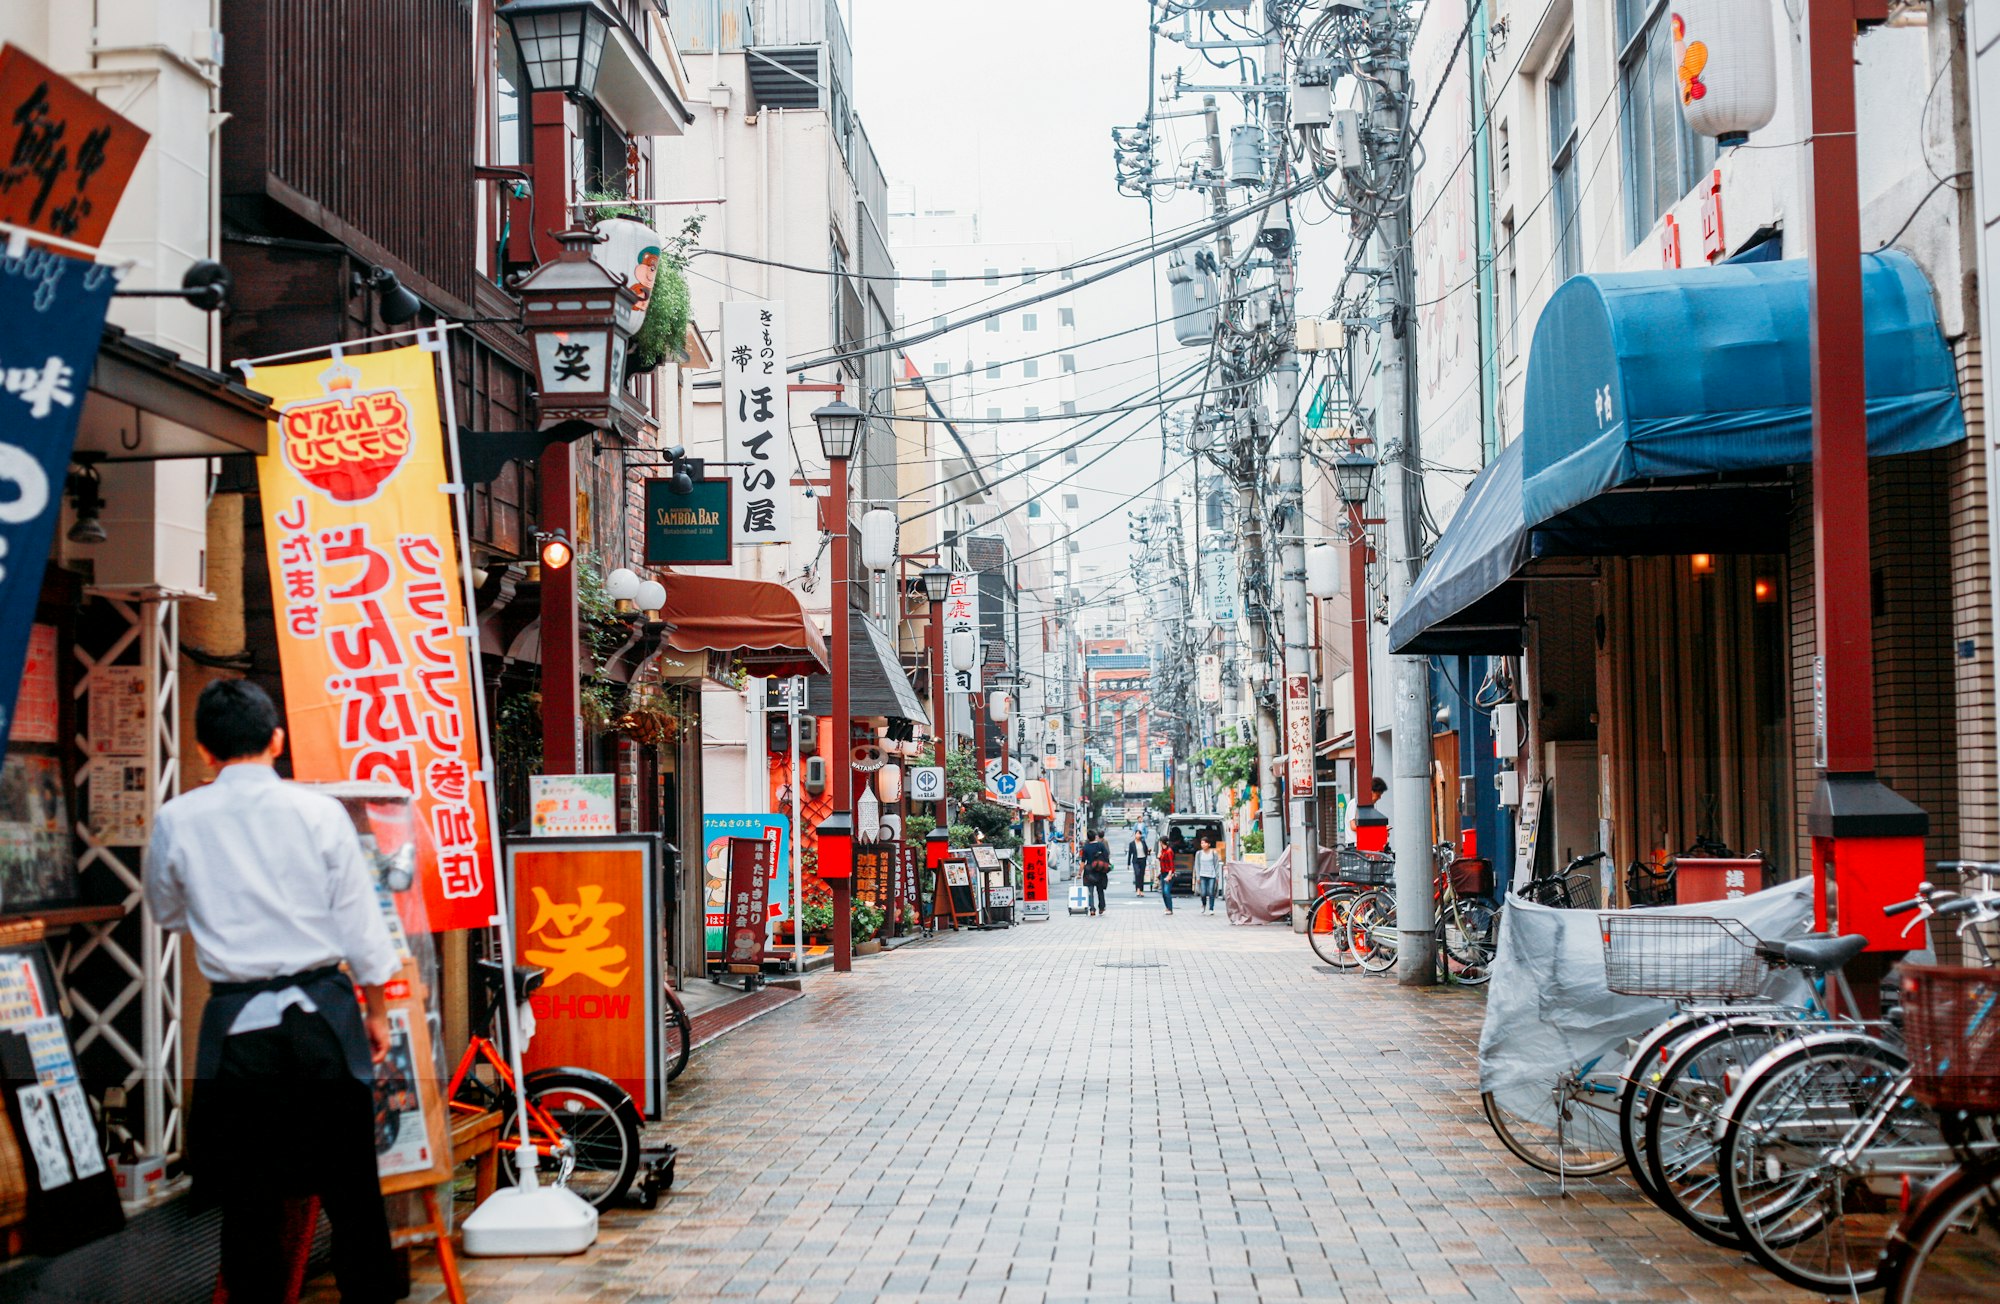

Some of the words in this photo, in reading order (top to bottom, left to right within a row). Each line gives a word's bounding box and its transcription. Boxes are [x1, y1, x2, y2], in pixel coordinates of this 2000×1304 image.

[731, 344, 753, 374] 帯
[760, 309, 775, 375] きものと
[553, 342, 591, 382] 笑
[739, 386, 776, 533] ほてい屋
[657, 508, 697, 525] SAMBOA
[698, 508, 720, 525] BAR
[1216, 564, 1227, 595] タカハシ
[851, 760, 885, 772] WATANABE
[736, 892, 749, 928] 商店会
[750, 863, 764, 925] たぬき通り
[524, 884, 630, 988] 笑
[529, 995, 631, 1019] SHOW
